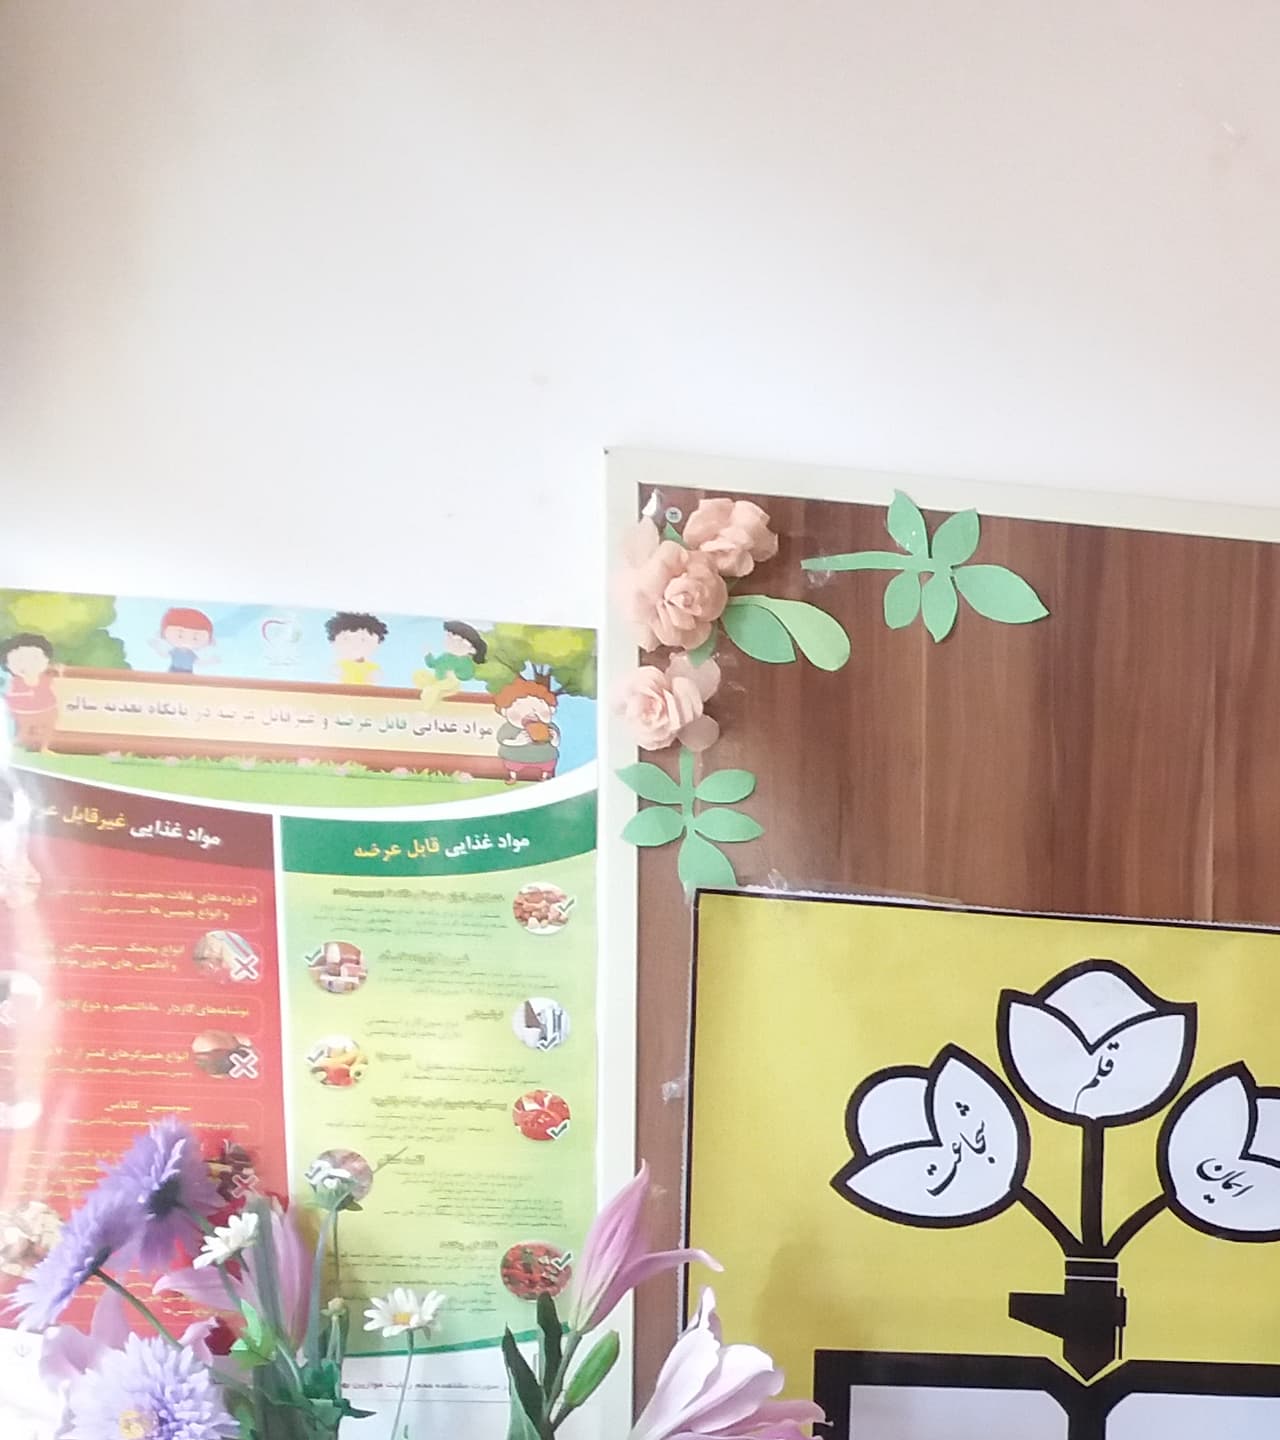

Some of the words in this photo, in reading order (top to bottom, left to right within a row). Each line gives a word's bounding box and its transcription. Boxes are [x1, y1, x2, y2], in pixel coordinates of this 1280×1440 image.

[130, 820, 184, 838] غذایی
[187, 826, 222, 850] مواد
[354, 843, 402, 862] عرضه
[407, 837, 440, 859] قابل
[445, 834, 493, 858] غذایی
[497, 833, 530, 854] مواد
